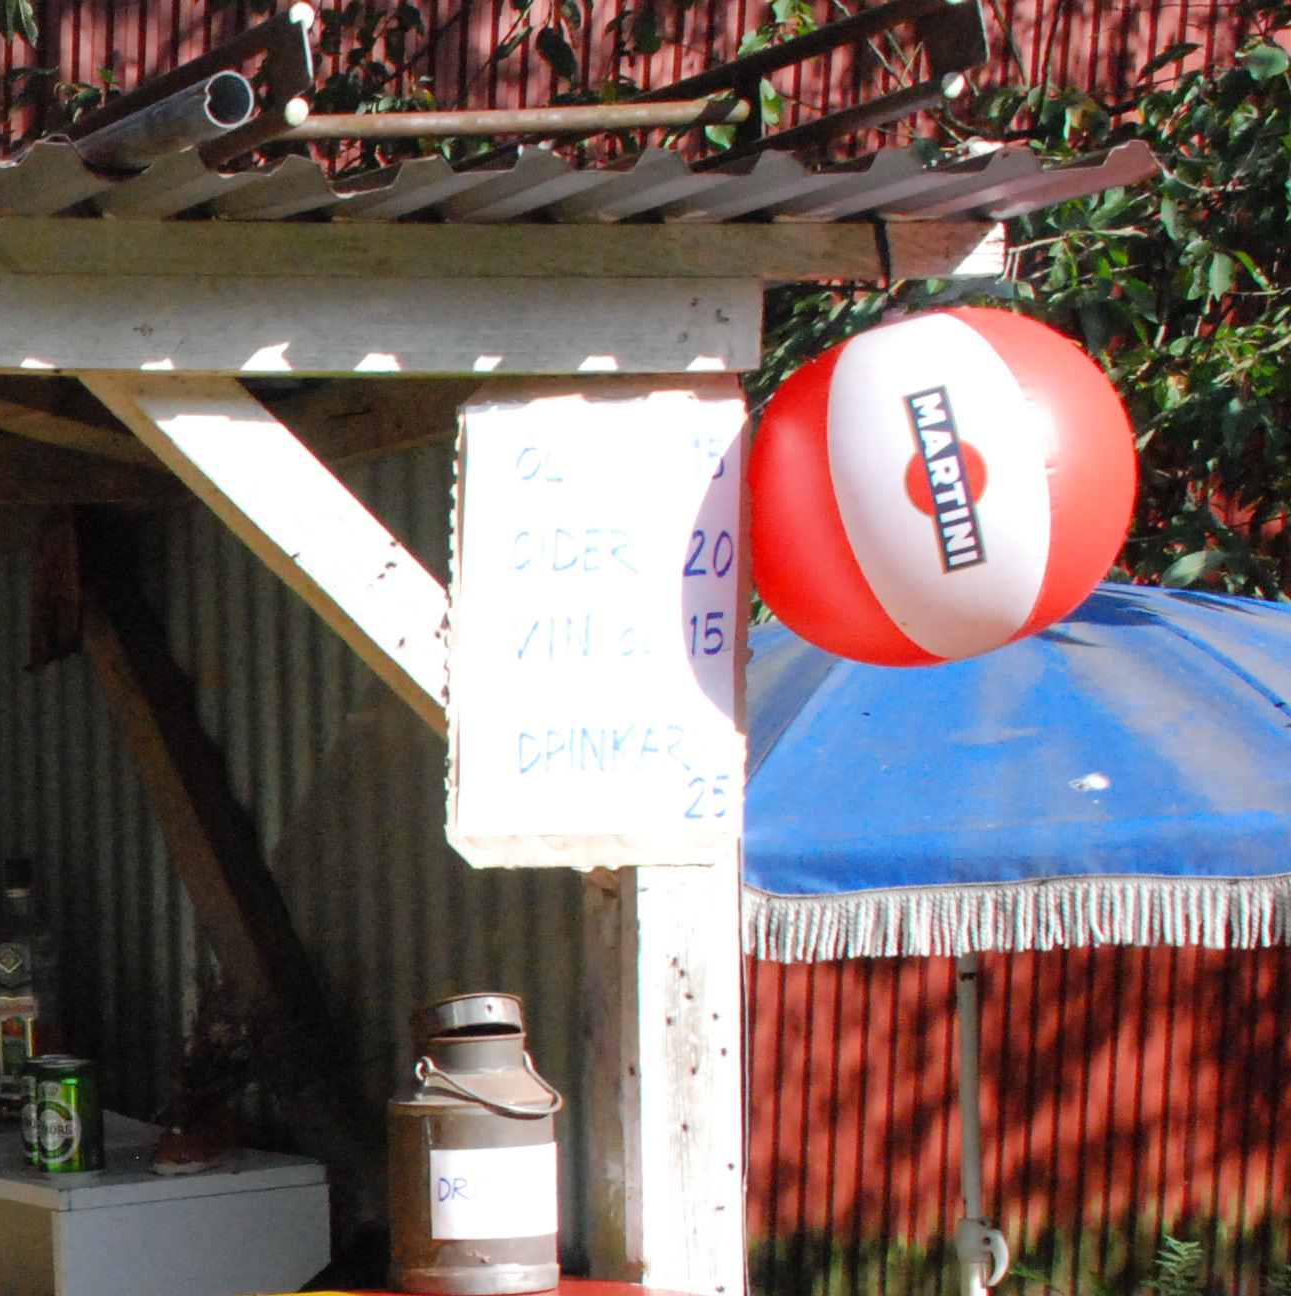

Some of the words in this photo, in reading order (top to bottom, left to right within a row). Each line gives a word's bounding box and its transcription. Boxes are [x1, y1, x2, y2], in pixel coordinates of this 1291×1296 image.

[911, 391, 981, 567] MARTINI
[511, 527, 640, 575] CIDER
[682, 529, 736, 578] 20
[513, 613, 591, 661] VIN
[689, 610, 727, 657] 15
[683, 774, 731, 821] 25
